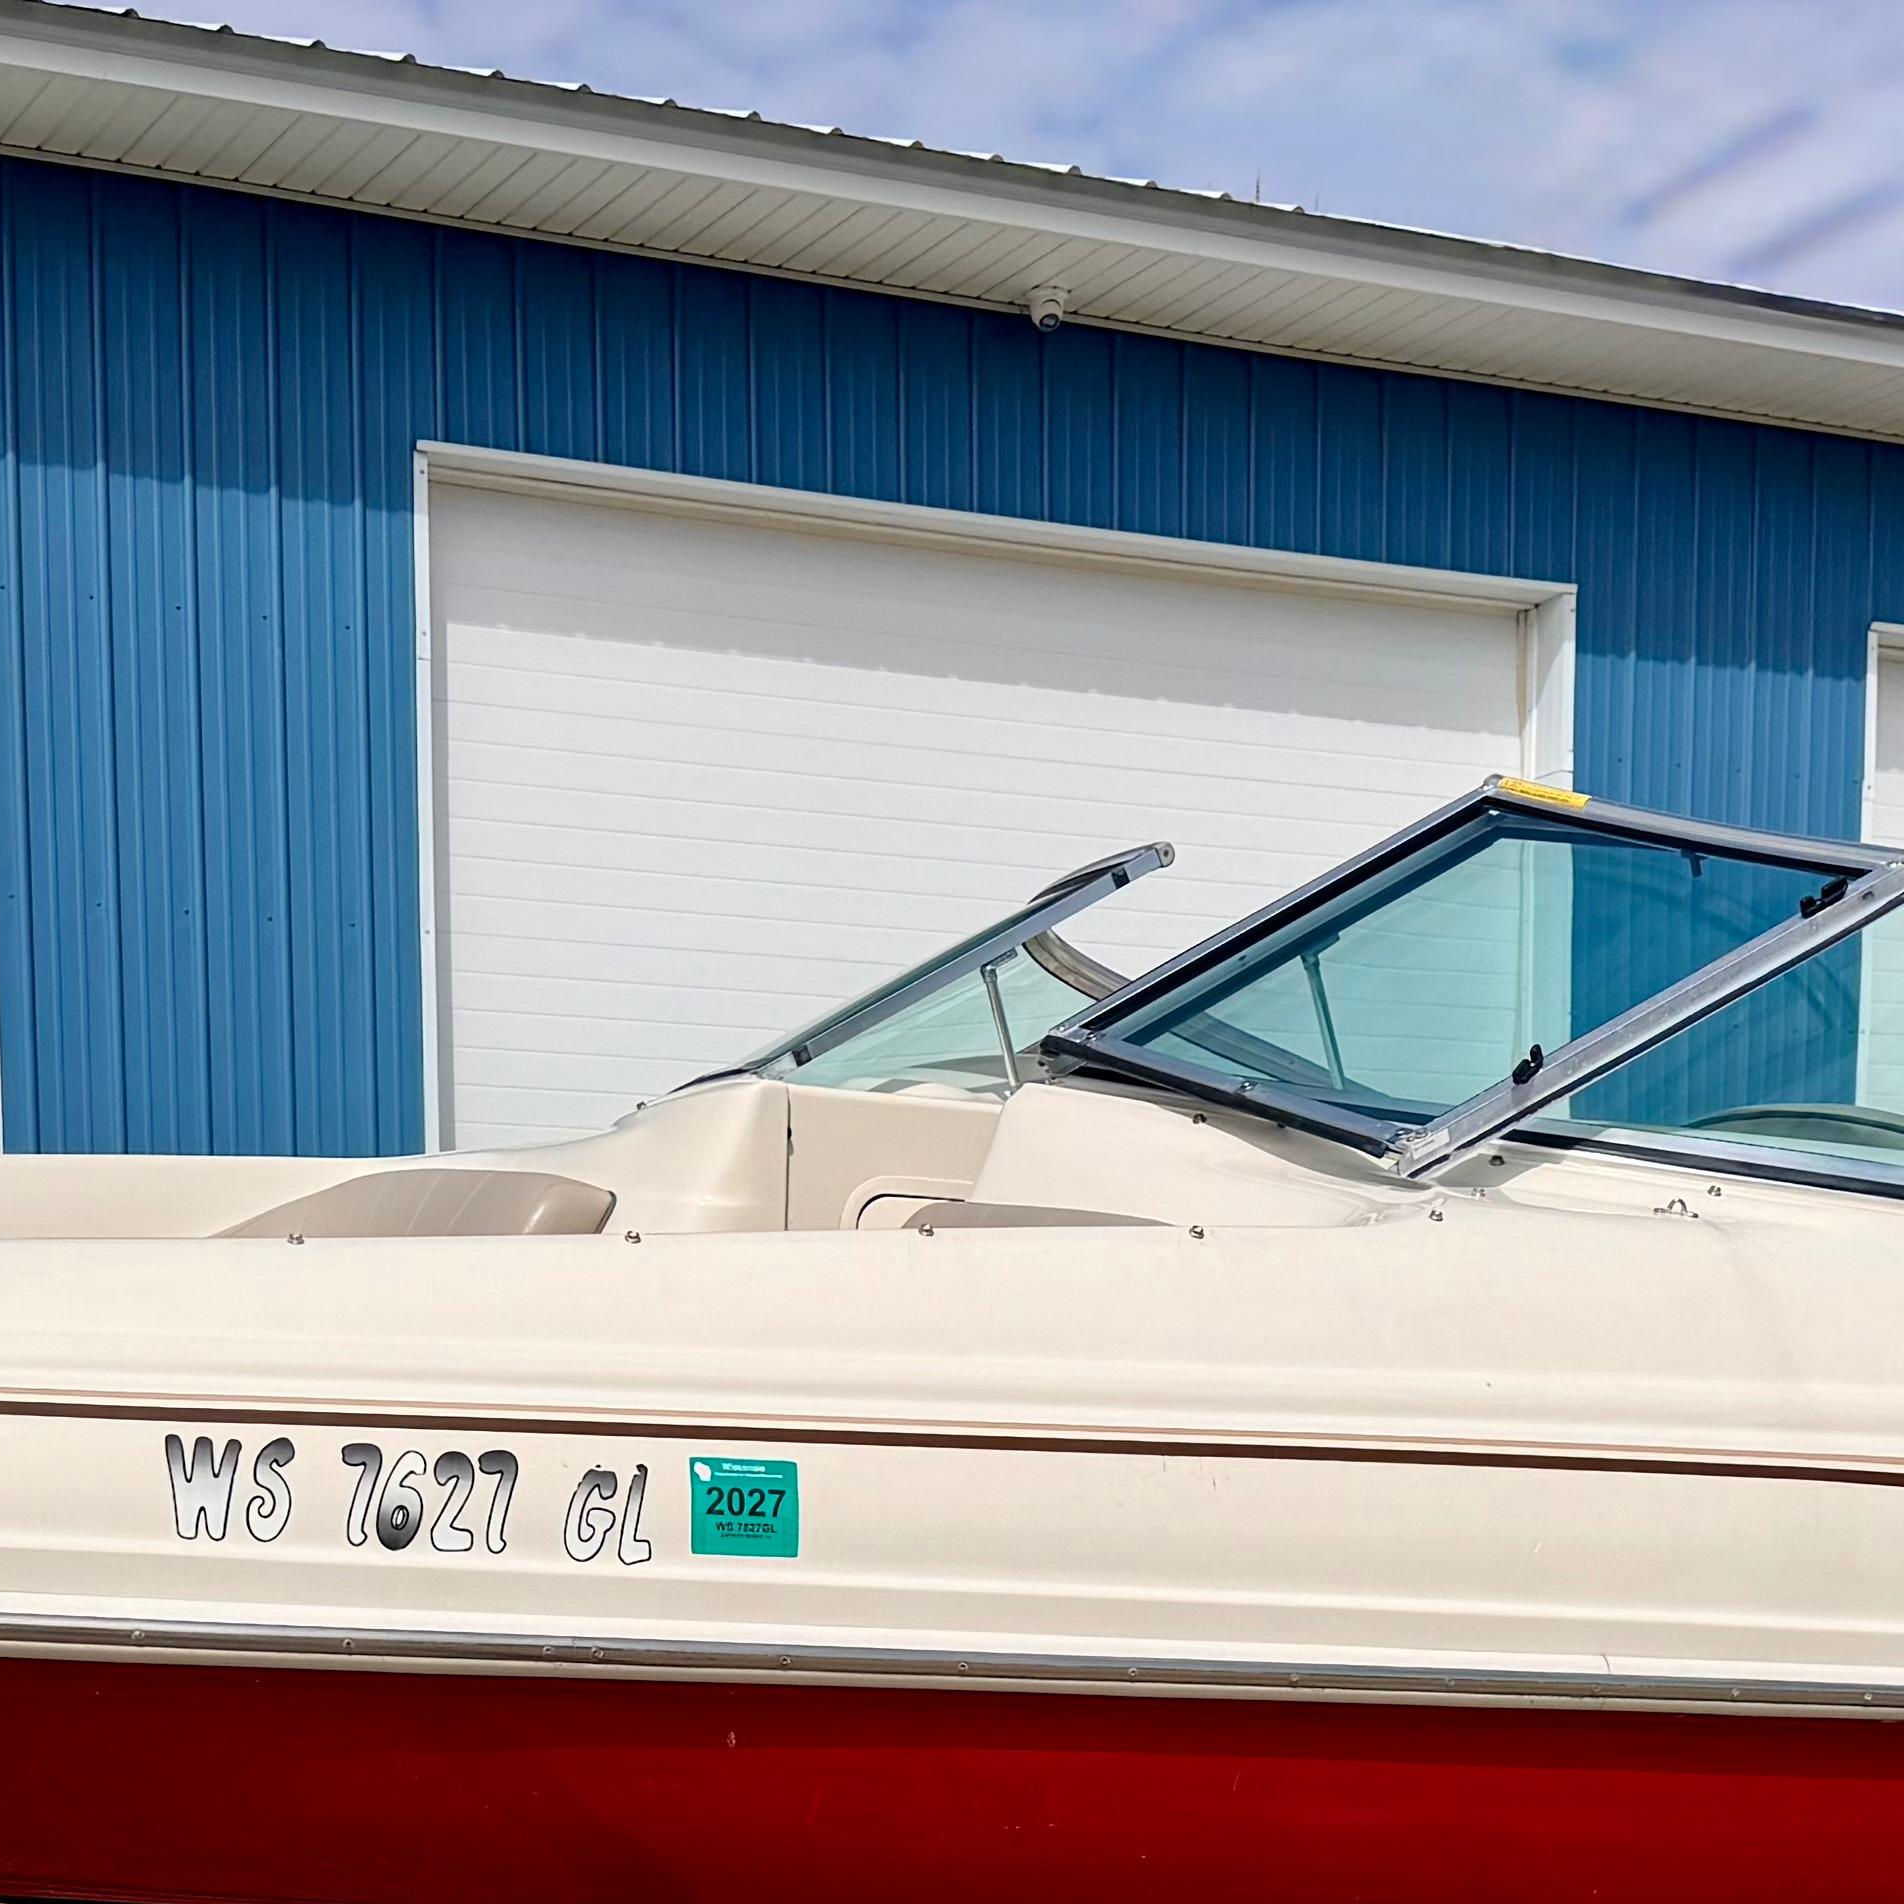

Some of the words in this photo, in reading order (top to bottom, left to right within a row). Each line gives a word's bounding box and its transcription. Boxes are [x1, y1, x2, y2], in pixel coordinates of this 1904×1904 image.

[165, 1434, 296, 1542] WS
[341, 1442, 519, 1554] 7627
[563, 1463, 652, 1566] GL
[705, 1486, 787, 1518] 2027
